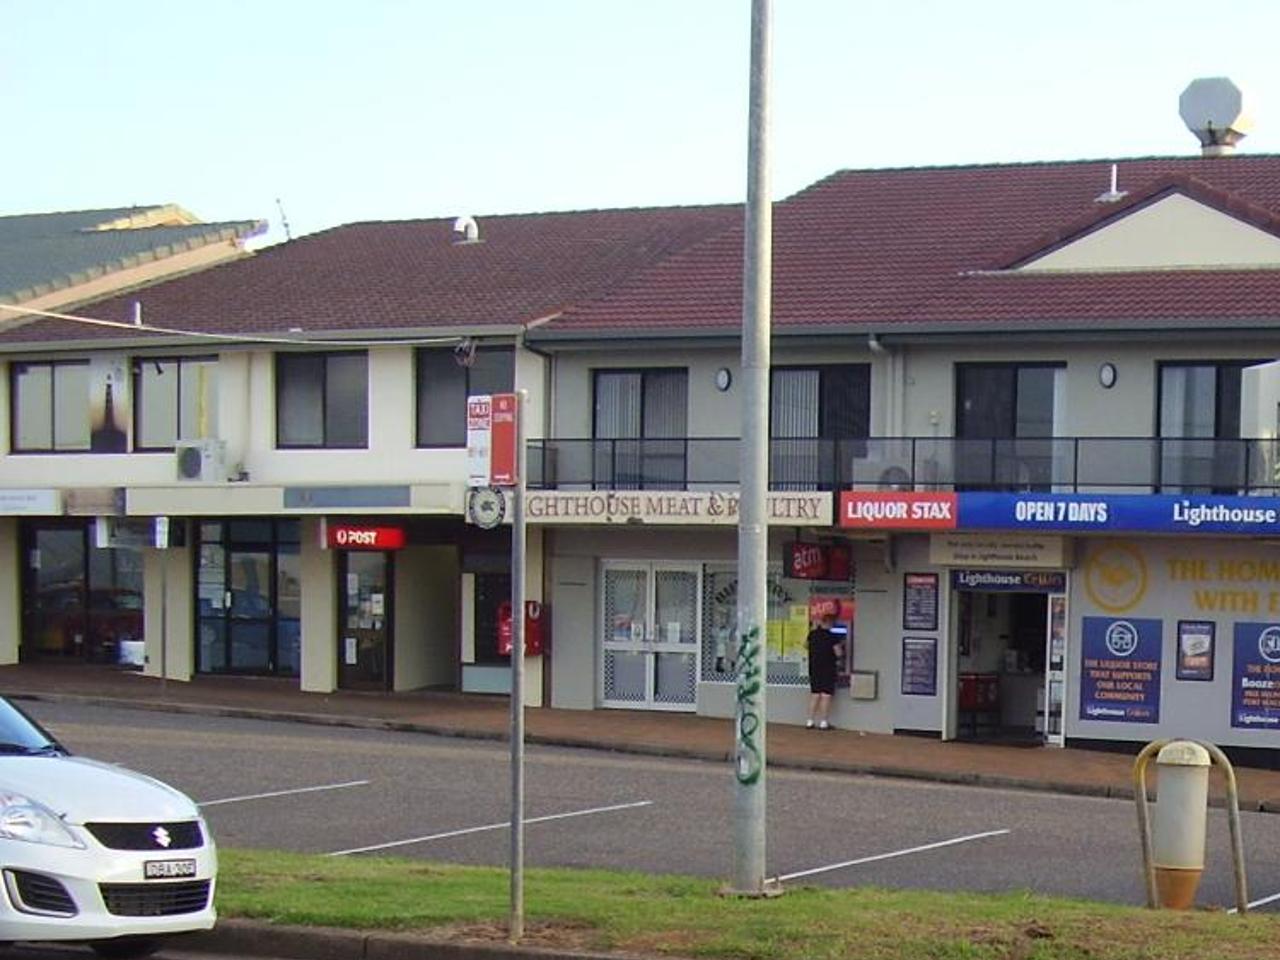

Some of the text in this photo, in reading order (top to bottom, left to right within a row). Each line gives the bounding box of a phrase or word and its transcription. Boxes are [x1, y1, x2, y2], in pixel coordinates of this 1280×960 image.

[525, 496, 640, 517] GHTHOUSE
[646, 497, 702, 517] MEAT
[707, 493, 724, 517] &
[727, 497, 822, 518] PLTRY
[847, 501, 951, 521] LIQUOR STAX
[1015, 501, 1108, 523] OPEN 7 DAYS
[1173, 500, 1276, 526] Lighthouse
[348, 531, 378, 545] POST
[959, 571, 1021, 587] Lighthouse
[1168, 558, 1213, 583] THE
[1195, 589, 1258, 614] WITH
